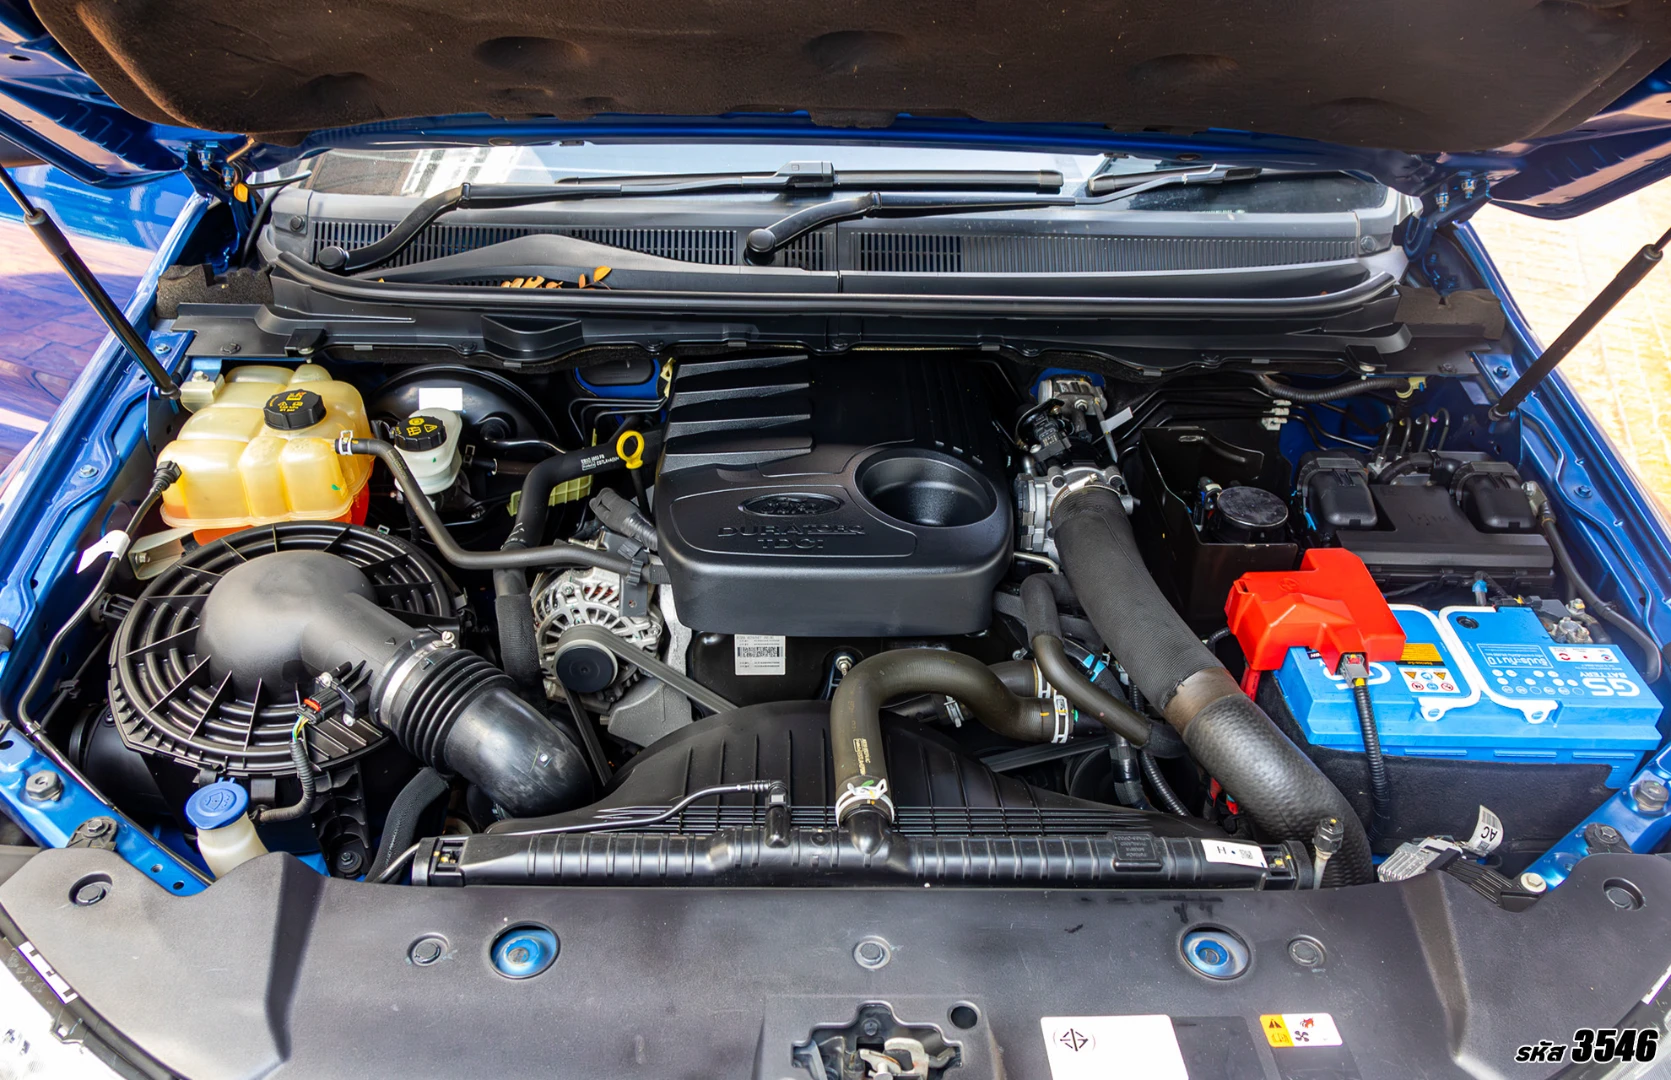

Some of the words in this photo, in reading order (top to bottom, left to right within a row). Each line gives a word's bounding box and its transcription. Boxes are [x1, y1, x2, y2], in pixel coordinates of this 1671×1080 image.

[718, 523, 866, 537] DURATORQ
[1580, 671, 1628, 679] BATTERY
[1582, 678, 1640, 697] GS
[1480, 826, 1498, 842] AC
